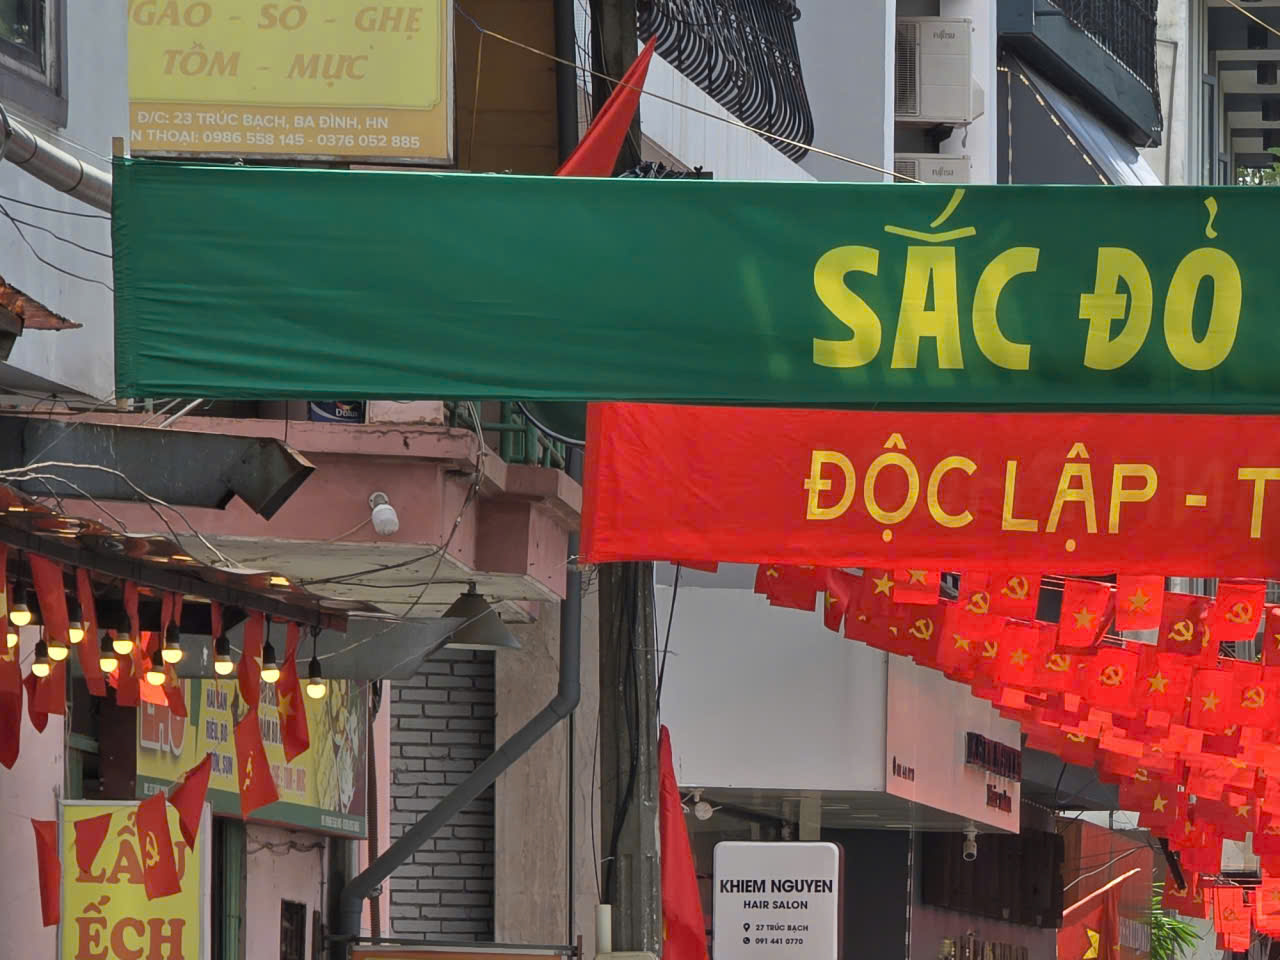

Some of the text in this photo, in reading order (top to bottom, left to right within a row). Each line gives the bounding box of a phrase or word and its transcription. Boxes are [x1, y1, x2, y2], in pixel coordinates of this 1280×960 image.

[354, 6, 423, 40] GHẸ
[288, 52, 369, 88] MỰC
[174, 112, 193, 125] 23
[196, 108, 239, 126] TRÚC
[243, 114, 289, 130] BẠCH,
[294, 115, 315, 129] BA
[319, 112, 361, 130] ĐÌNH,
[366, 116, 389, 129] HN
[203, 131, 242, 144] 0986
[246, 132, 274, 145] 558
[279, 133, 305, 145] 145
[317, 133, 354, 146] 0376
[358, 134, 388, 147] 052
[392, 135, 421, 149] 885
[812, 188, 1040, 371] SẮC
[1078, 196, 1243, 371] ĐỎ
[804, 433, 978, 542] ĐỘC
[1001, 442, 1158, 552] LẬP
[720, 879, 833, 894] KHIEM NGUYEN
[743, 900, 808, 910] HAIR SALON
[755, 922, 809, 933] 27 TRÚC BẠCH
[755, 937, 803, 945] 091 441 0770
